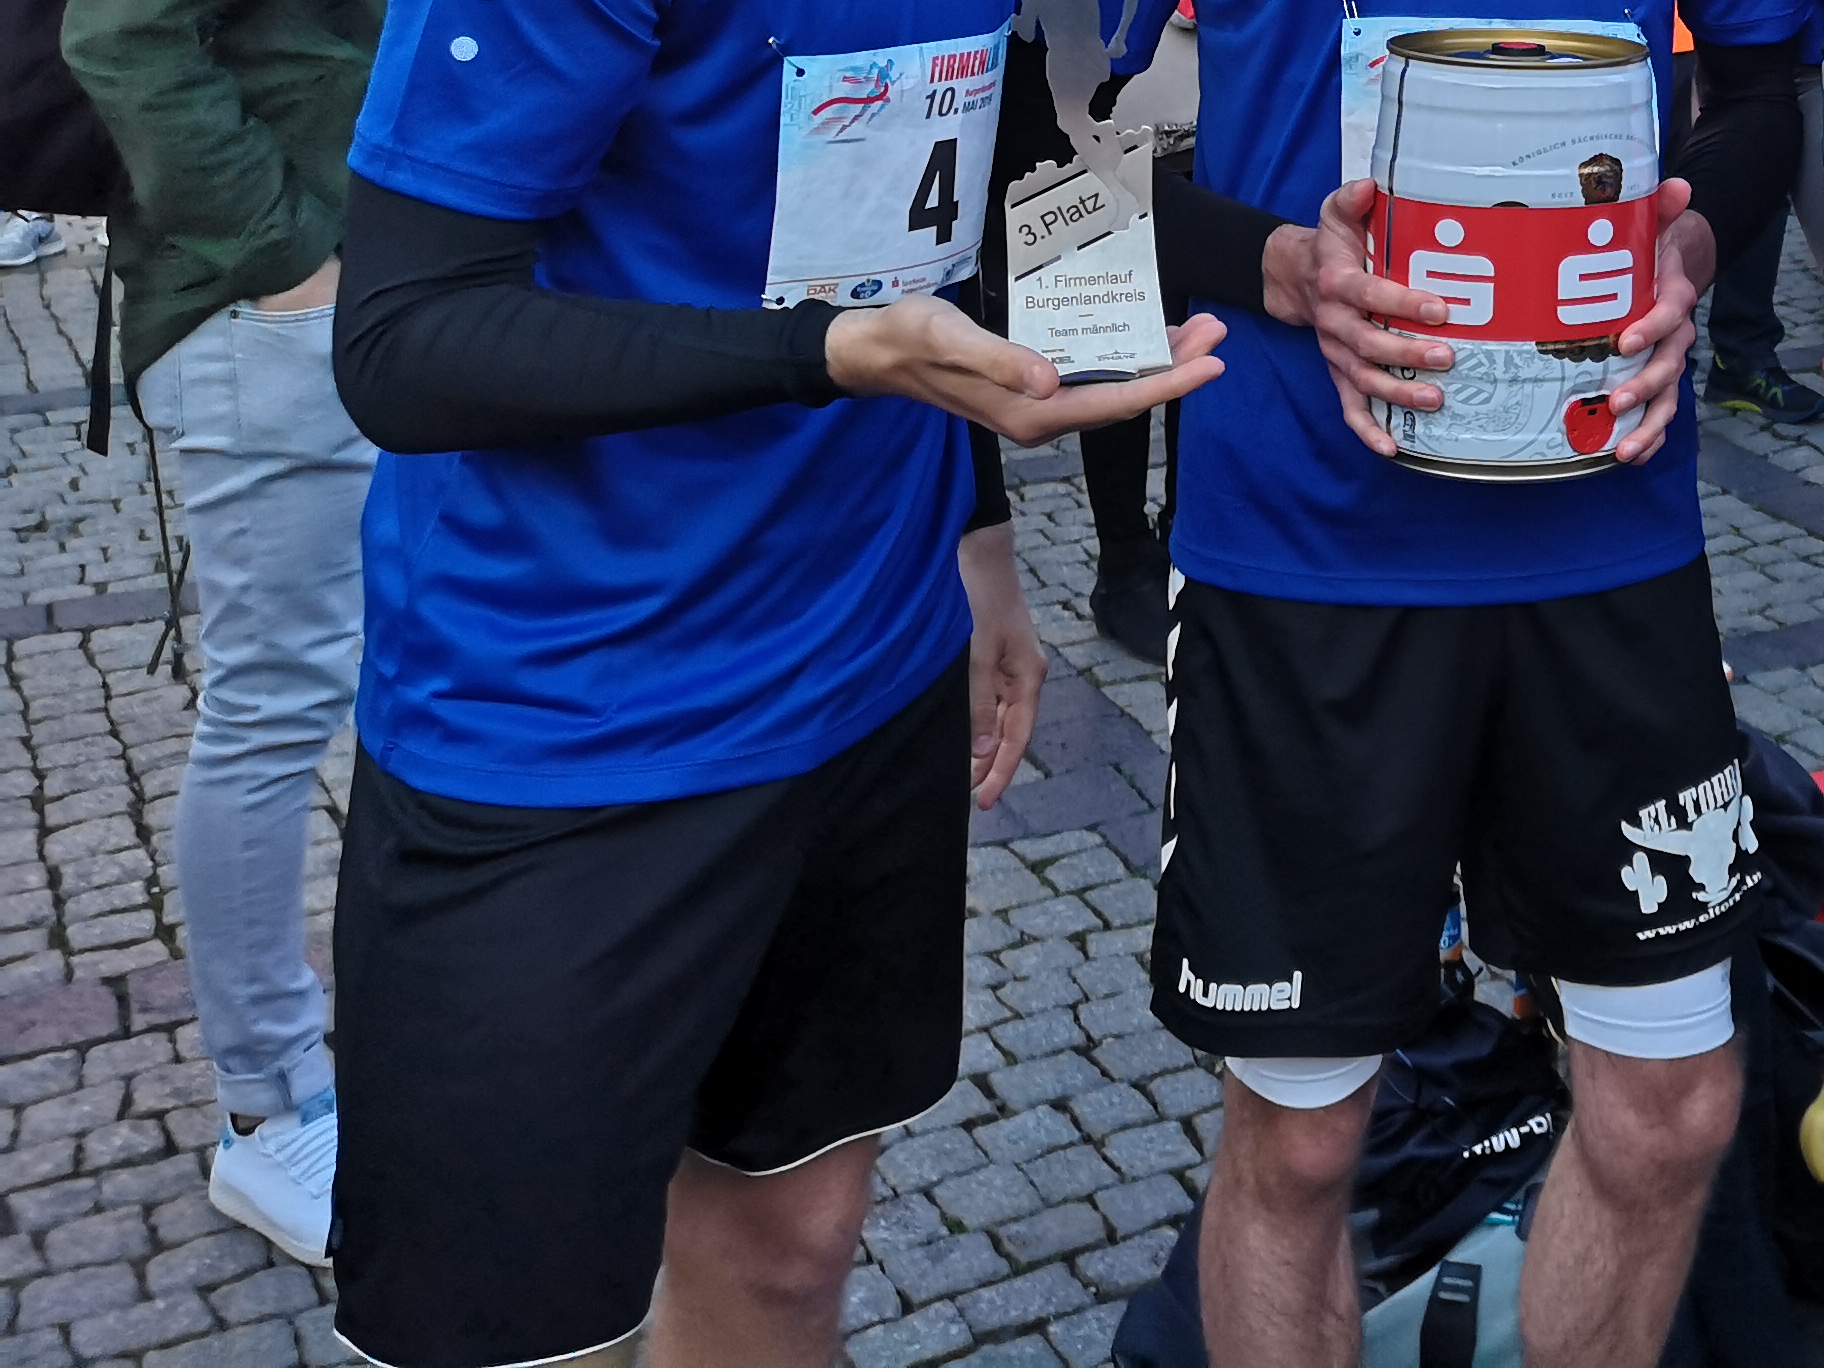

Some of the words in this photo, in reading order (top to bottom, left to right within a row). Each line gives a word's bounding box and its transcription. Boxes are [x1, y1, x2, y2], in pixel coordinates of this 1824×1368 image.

[925, 87, 960, 119] 10.
[962, 99, 978, 114] MAI
[908, 138, 959, 247] 4
[1018, 191, 1106, 247] 3.Platz
[1036, 276, 1049, 290] 1.
[1054, 269, 1134, 289] Firmenlauf
[1025, 288, 1146, 311] Burgenlandkreis
[1048, 326, 1079, 338] Team
[1081, 322, 1131, 336] männlich
[1638, 798, 1677, 840] EL
[1178, 958, 1303, 1012] hummel
